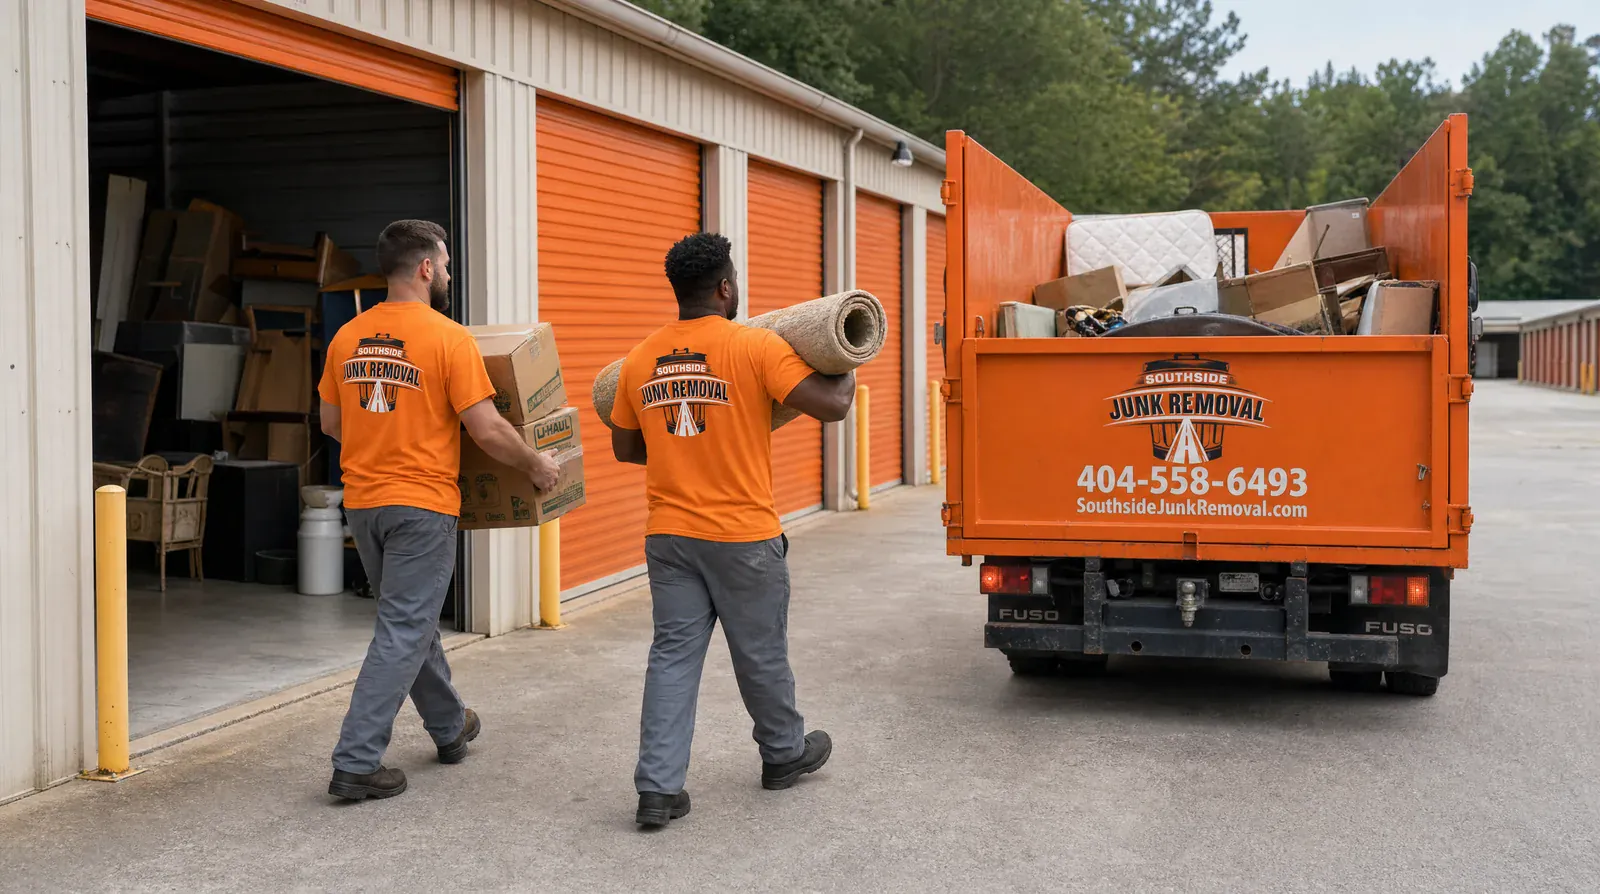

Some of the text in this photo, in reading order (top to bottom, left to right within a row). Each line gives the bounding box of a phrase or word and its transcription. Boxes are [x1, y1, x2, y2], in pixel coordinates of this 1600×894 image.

[358, 346, 403, 358] SOUTHSIDE
[343, 361, 420, 387] JUNK REMOVAL
[657, 364, 707, 375] SOUTHSIDE
[1145, 372, 1228, 384] SOUTHSIDE
[641, 380, 729, 405] JUNK REMOVAL
[1109, 393, 1265, 422] JUNK REMOVAL
[536, 419, 570, 440] U-HAUL
[1077, 465, 1308, 497] 404-558-6493
[1076, 497, 1308, 518] SouthsideJunkRemoval.com
[999, 608, 1060, 621] FUSO
[1365, 621, 1433, 636] FUSO
